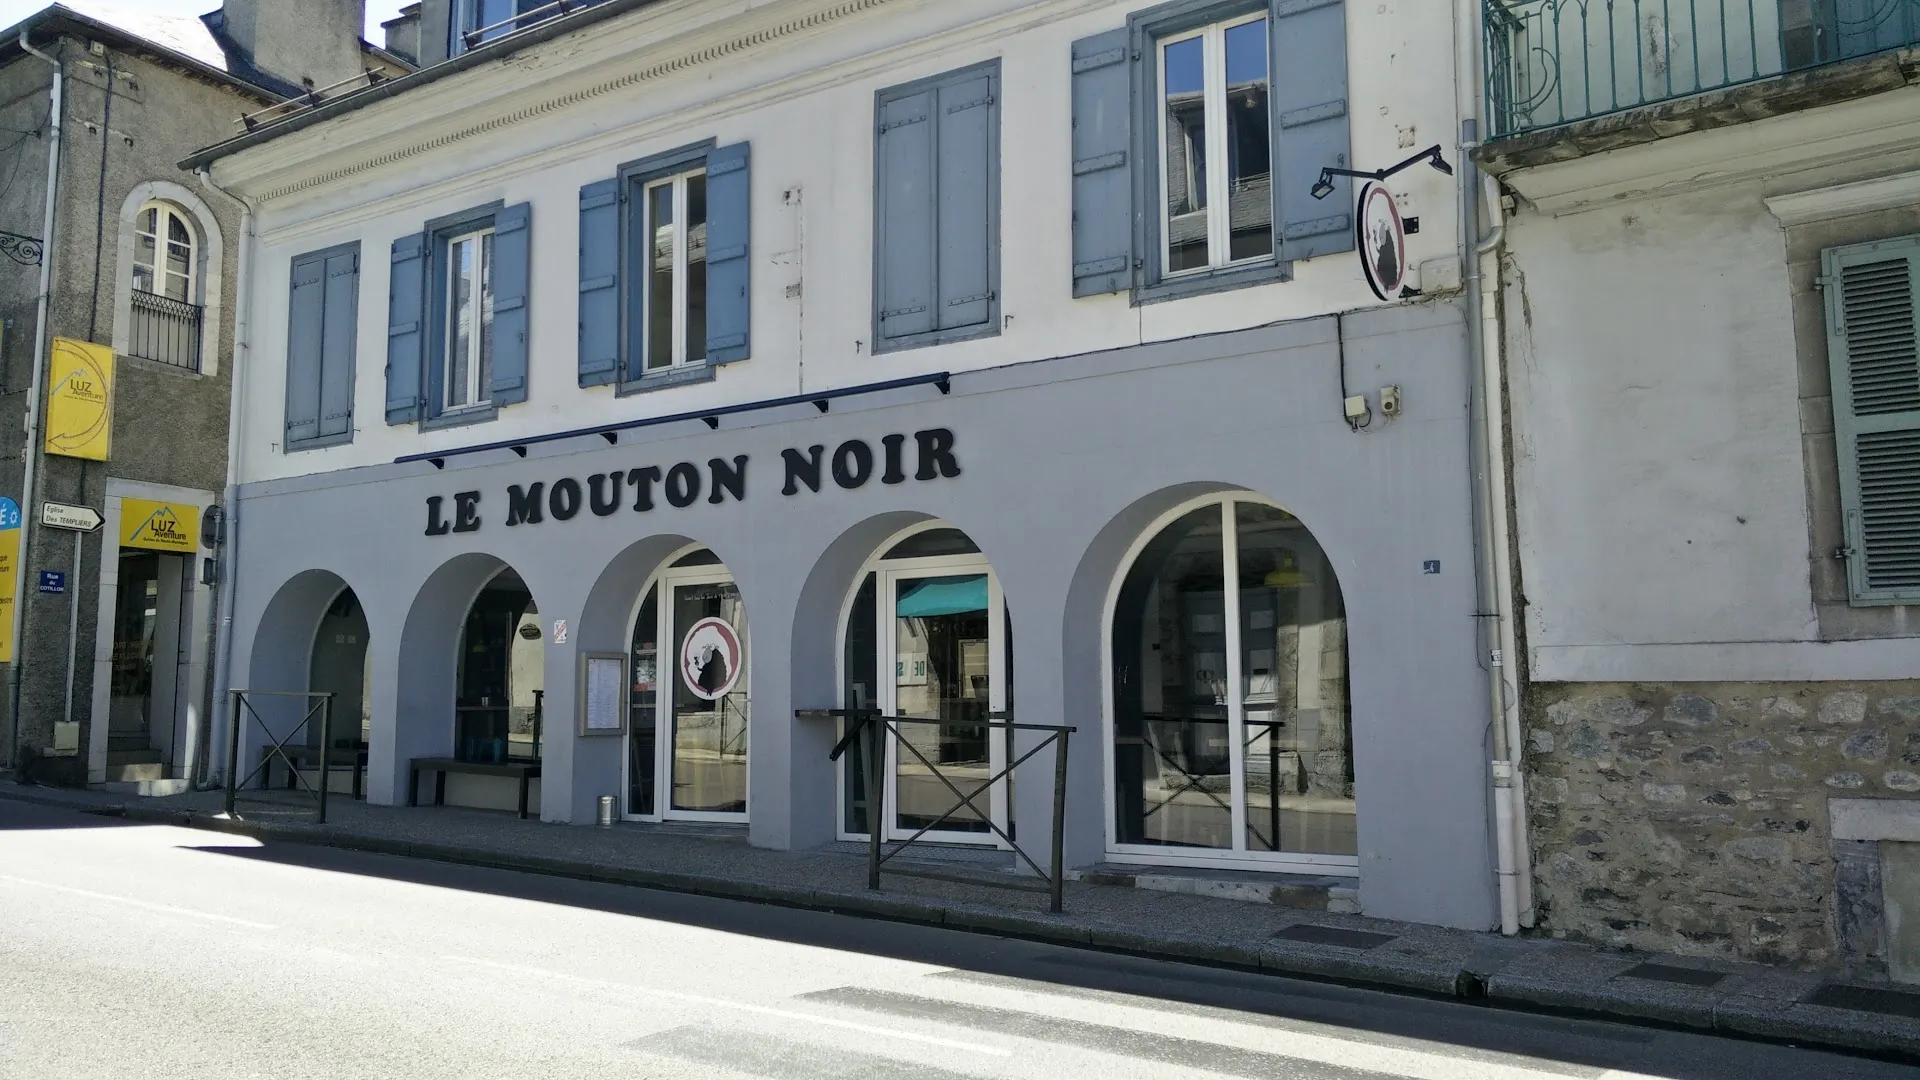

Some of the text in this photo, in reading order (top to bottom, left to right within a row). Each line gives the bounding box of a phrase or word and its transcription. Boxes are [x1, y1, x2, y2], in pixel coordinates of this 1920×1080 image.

[70, 378, 91, 392] LUZ
[72, 389, 105, 401] Aventure
[424, 427, 962, 536] LE MOUTON NOIR
[46, 505, 64, 514] Eglise
[59, 516, 92, 527] TEMPLIERS
[151, 519, 176, 533] LUZ
[154, 530, 187, 540] Aventure
